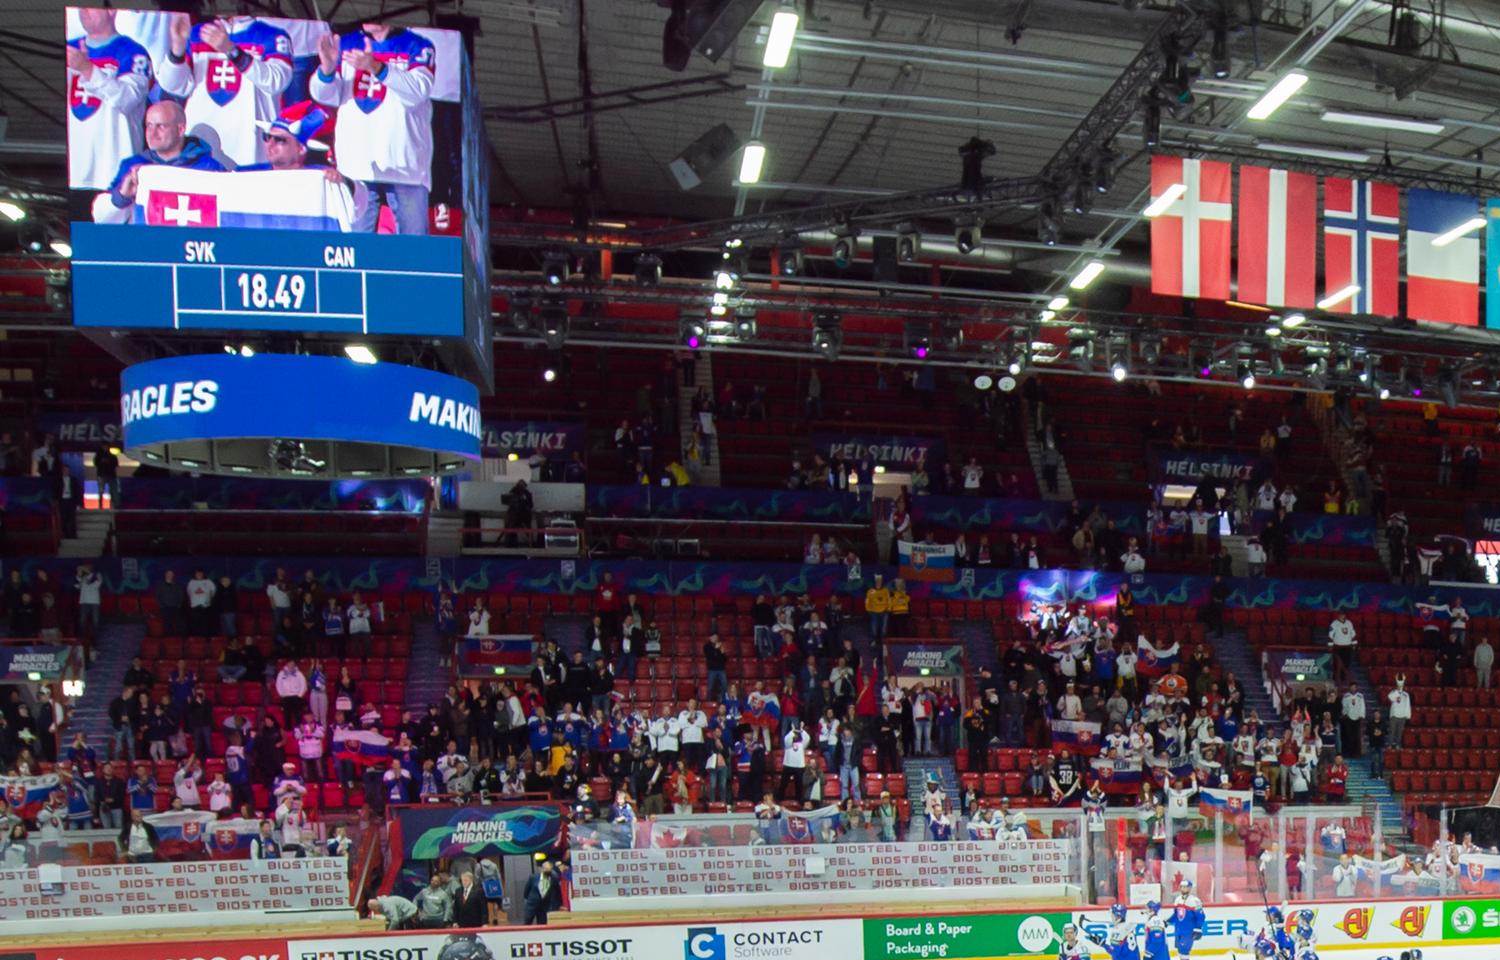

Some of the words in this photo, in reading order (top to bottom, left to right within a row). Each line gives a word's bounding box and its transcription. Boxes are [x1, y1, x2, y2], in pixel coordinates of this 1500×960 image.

[184, 241, 216, 263] SVK
[324, 246, 356, 268] CAN
[237, 272, 306, 310] 18.49
[121, 380, 220, 426] RACLES
[409, 391, 481, 438] MAKIN
[13, 653, 56, 663] MAKING
[8, 662, 61, 673] MIRACLES
[456, 820, 507, 833] MAKING
[451, 831, 514, 844] MIRACLES
[578, 851, 649, 861] BIOSTEEL
[665, 848, 736, 859] BIOSTEEL
[752, 847, 820, 856] BIOSTEEL
[836, 844, 902, 854] BIOSTEEL
[917, 843, 982, 852] BIOSTEEL
[77, 867, 153, 877] BIOSTEEL
[172, 863, 249, 873] BIOSTEEL
[267, 859, 343, 870] BIOSTEEL
[616, 862, 686, 872] BIOSTEEL
[703, 860, 772, 870] BIOSTEEL
[871, 855, 938, 865] BIOSTEEL
[952, 853, 1017, 862] BIOSTEEL
[119, 878, 196, 889] BIOSTEEL
[214, 873, 290, 885] BIOSTEEL
[579, 875, 650, 886] BIOSTEEL
[666, 872, 737, 883] BIOSTEEL
[836, 868, 903, 878] BIOSTEEL
[918, 866, 983, 876] BIOSTEEL
[998, 864, 1062, 873] BIOSTEEL
[789, 881, 856, 892] BIOSTEEL
[952, 876, 1018, 886] BIOSTEEL
[80, 892, 156, 903] BIOSTEEL
[174, 888, 250, 899] BIOSTEEL
[269, 885, 344, 895] BIOSTEEL
[26, 907, 103, 919] BIOSTEEL
[121, 904, 198, 915] BIOSTEEL
[215, 900, 292, 911] BIOSTEEL
[733, 929, 824, 947] CONTACT
[886, 923, 922, 938] Board
[924, 923, 936, 935] &
[938, 922, 973, 938] Paper
[1021, 927, 1051, 941] MM
[545, 939, 633, 957] TISSOT
[733, 943, 793, 960] Software
[886, 941, 948, 958] Packaging
